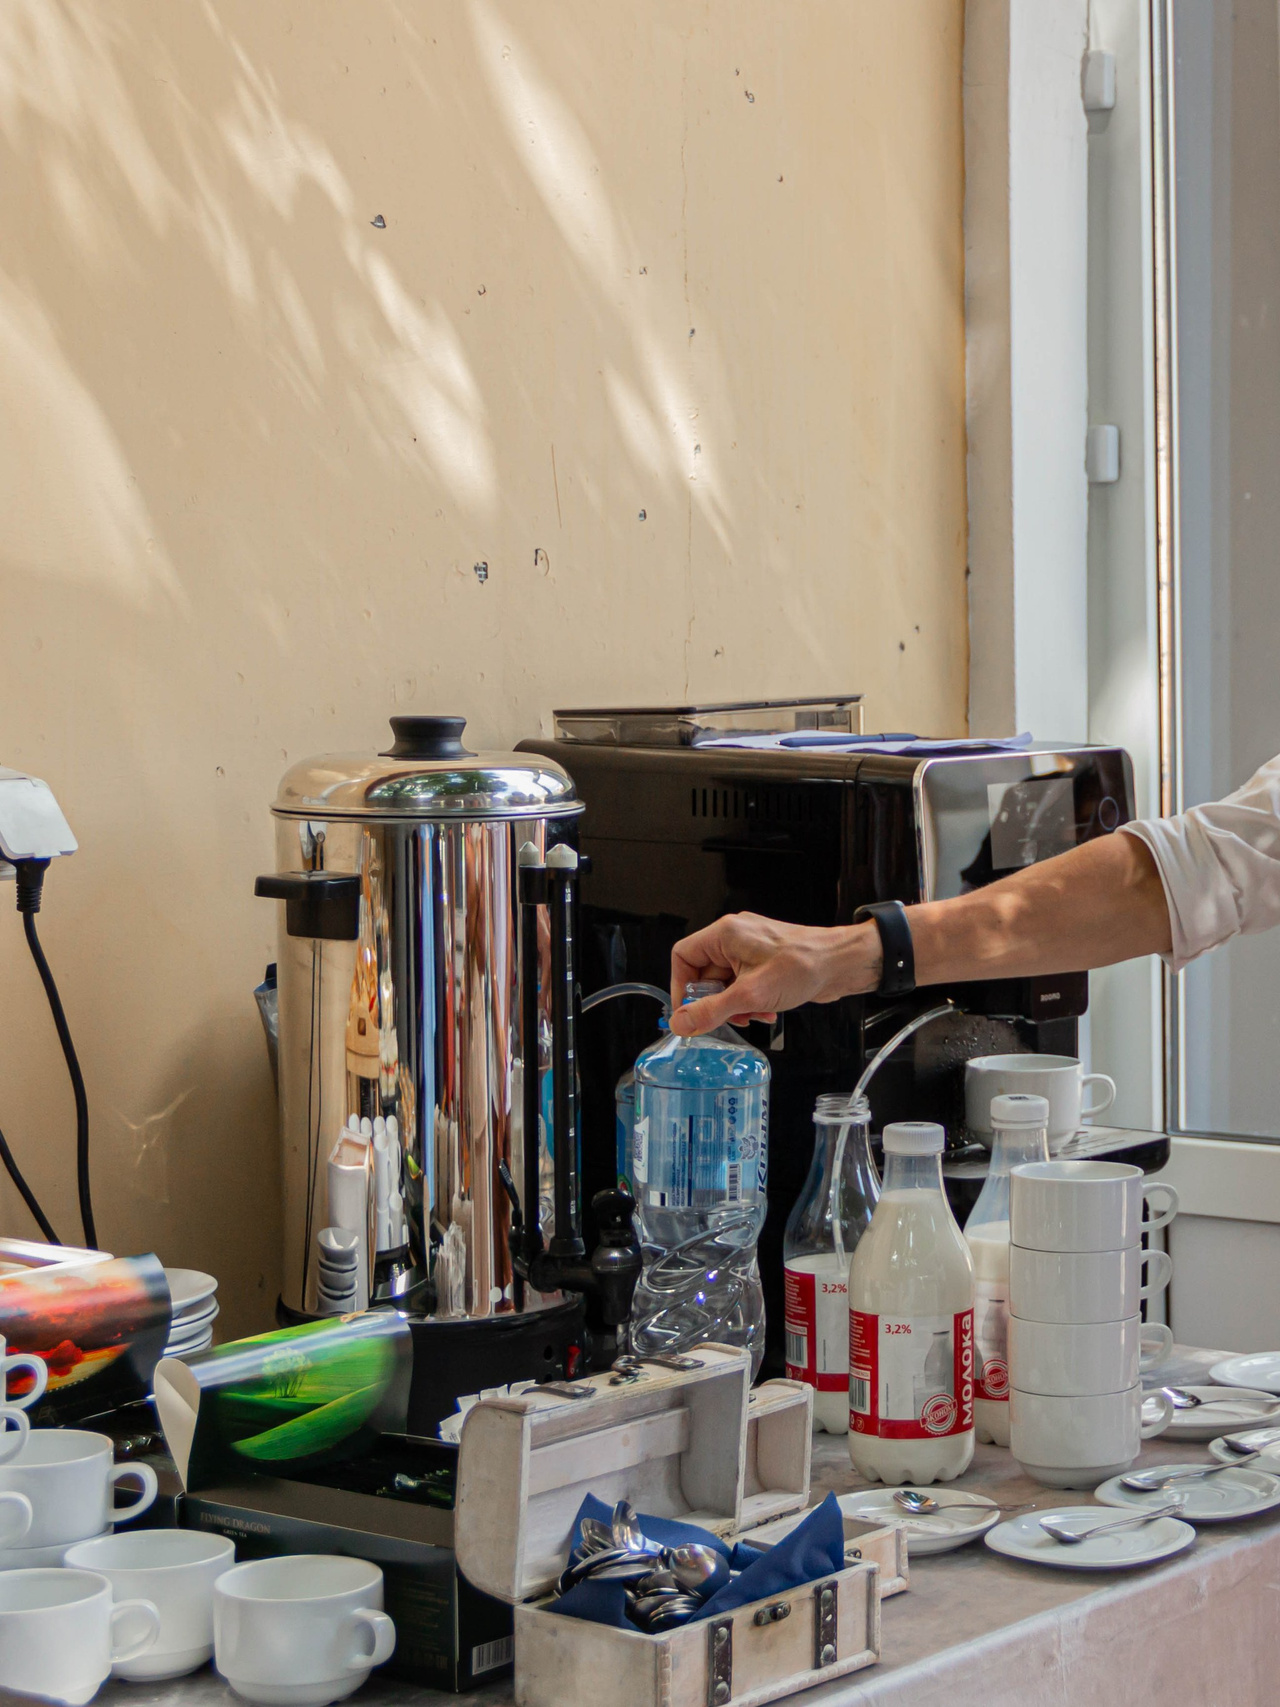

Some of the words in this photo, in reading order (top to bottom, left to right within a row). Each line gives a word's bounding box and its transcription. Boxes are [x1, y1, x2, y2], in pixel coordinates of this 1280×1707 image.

[821, 1283, 848, 1294] 3,2%
[884, 1323, 912, 1335] 3,2%
[200, 1511, 230, 1527] FLYING
[232, 1518, 271, 1534] DRAGON
